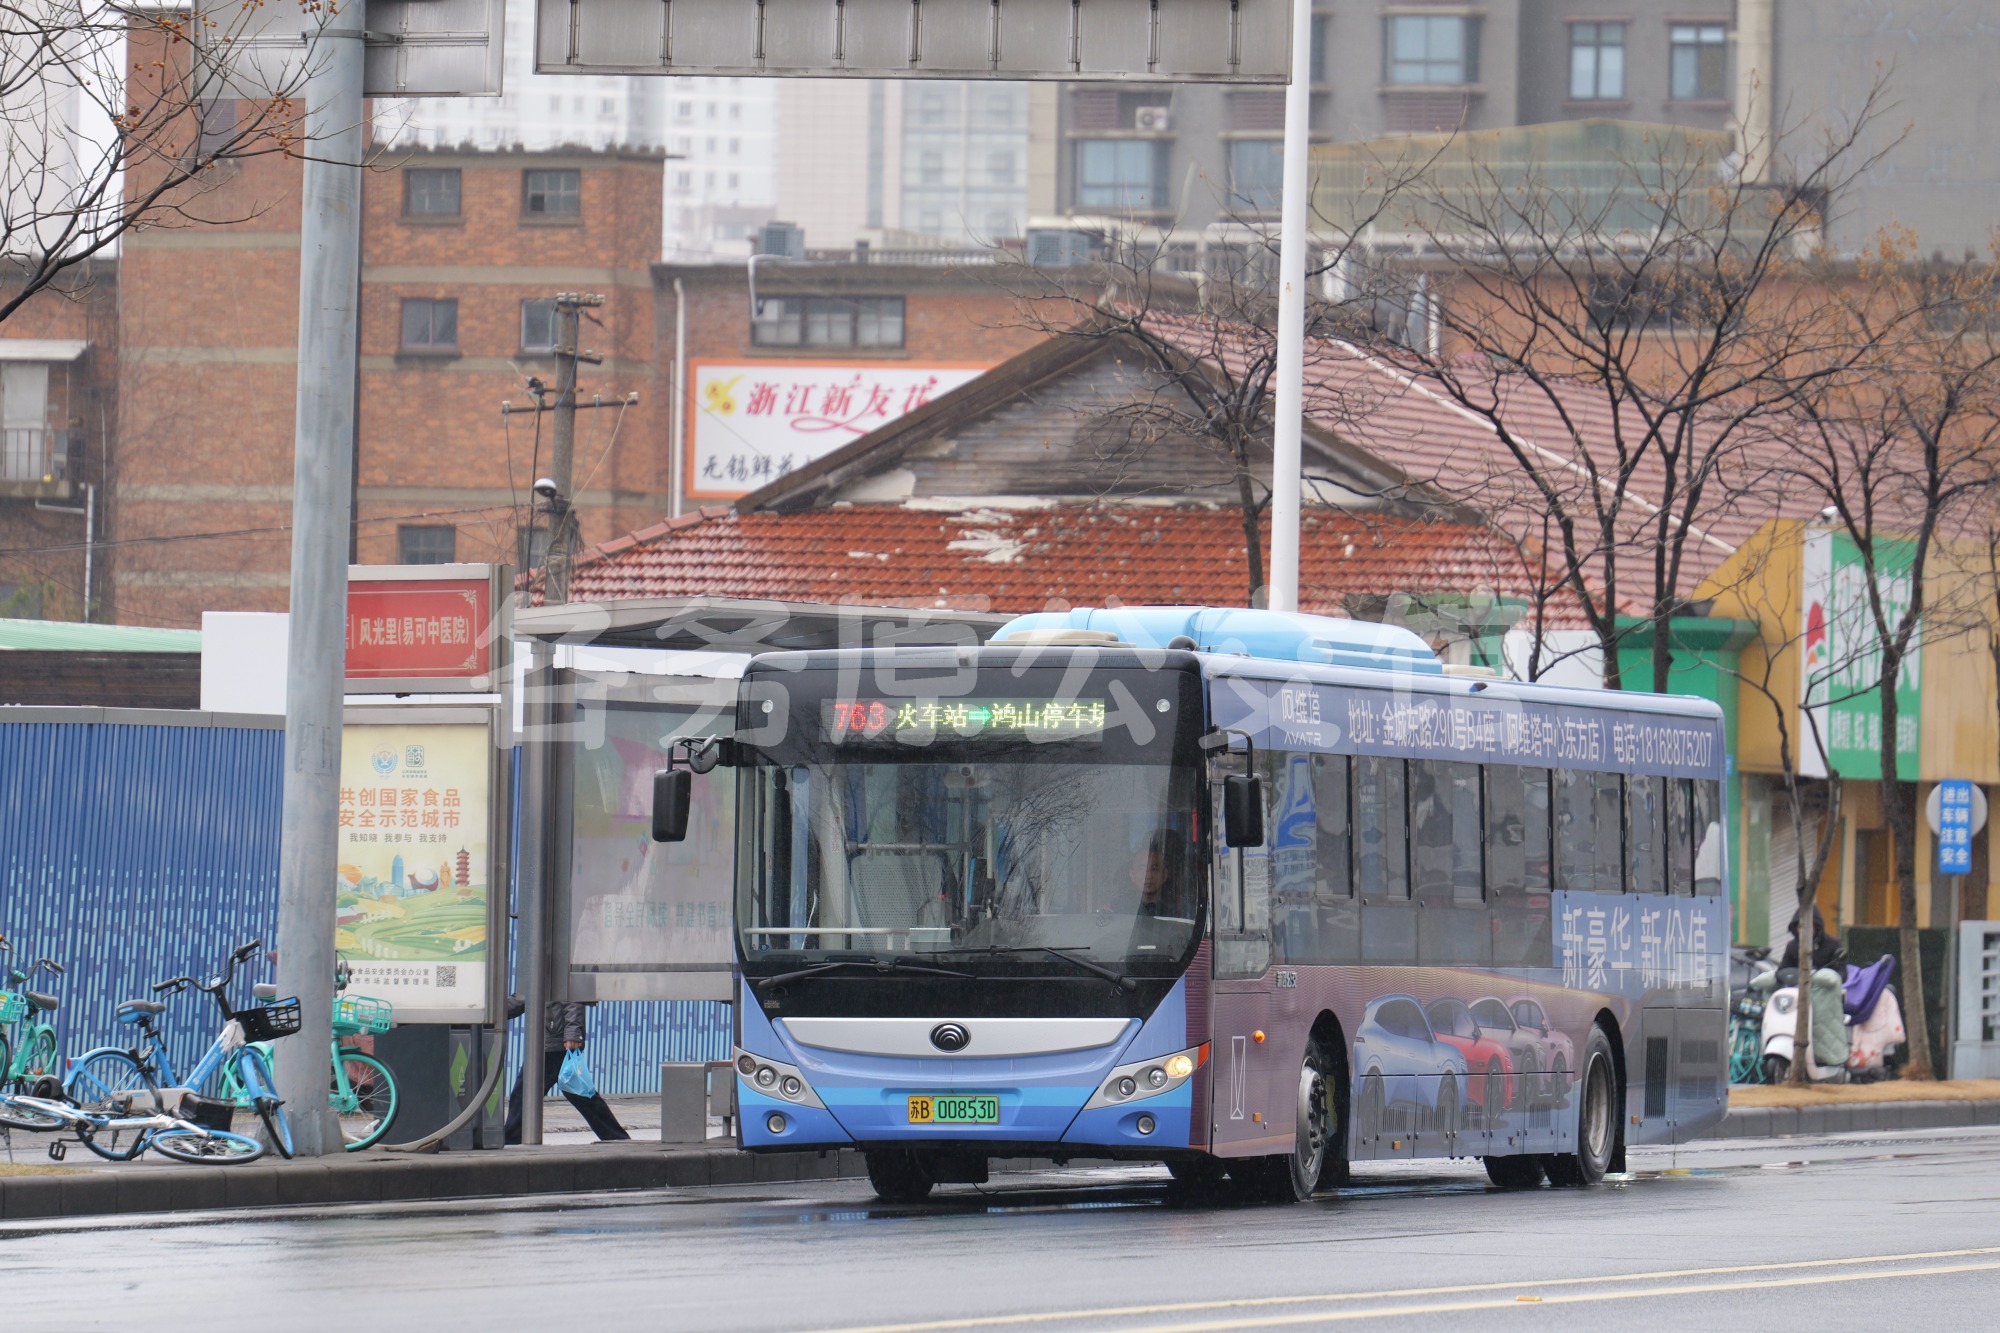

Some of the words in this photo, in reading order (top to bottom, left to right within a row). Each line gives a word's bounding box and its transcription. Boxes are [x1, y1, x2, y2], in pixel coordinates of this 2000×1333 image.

[359, 616, 470, 646] 风光里(易可中医院)
[1281, 688, 1321, 725] 阿维塔
[834, 703, 884, 730] 763
[896, 703, 968, 730] 火车站
[1284, 730, 1322, 746] AVATR
[339, 787, 461, 808] 共创国家食品
[1943, 786, 1969, 804] 进出
[339, 809, 461, 828] 安全示范城市
[1942, 807, 1969, 824] 车辆
[349, 833, 378, 843] 我知晓
[384, 833, 412, 843] 我参与
[419, 833, 447, 843] 我支持
[1941, 827, 1968, 844] 注意
[1941, 847, 1968, 865] 安全
[676, 900, 733, 928] 共建书香社
[1562, 904, 1632, 990] 新豪华
[1640, 907, 1708, 990] 新价值
[910, 1100, 930, 1119] 苏B
[938, 1100, 996, 1119] 00853D
